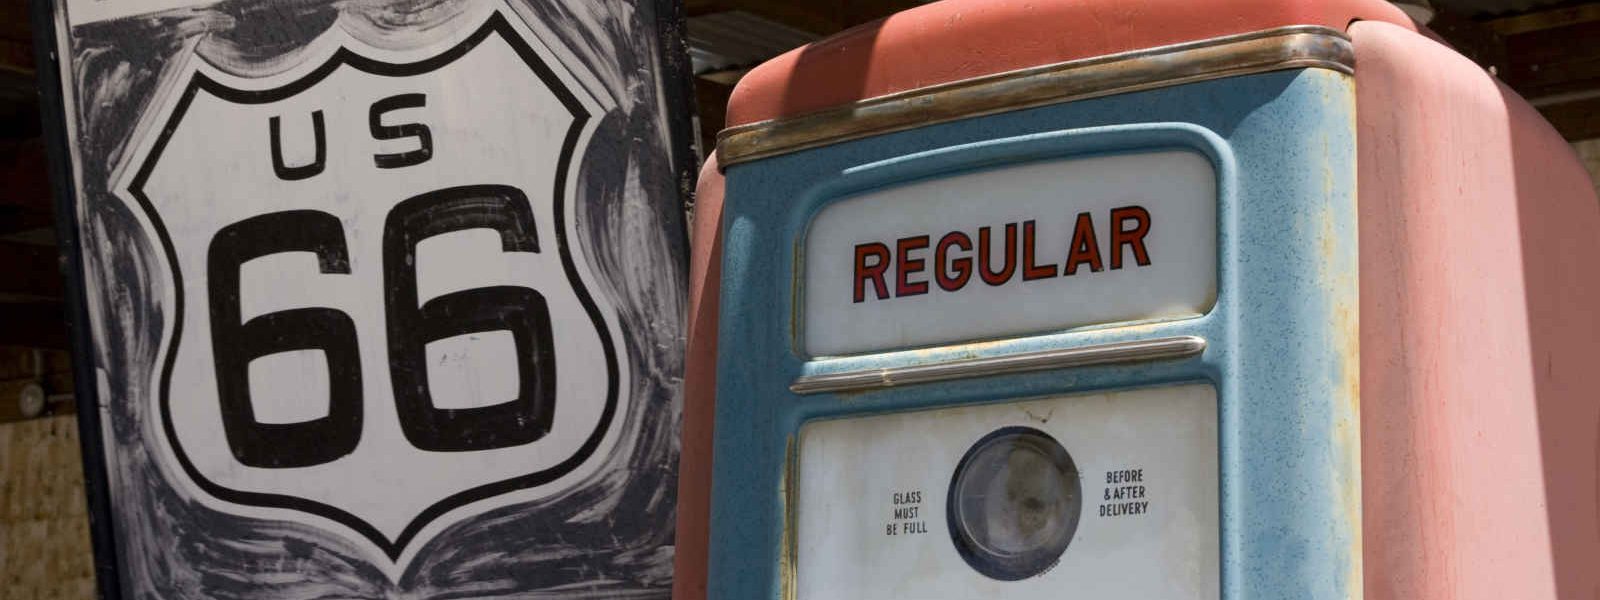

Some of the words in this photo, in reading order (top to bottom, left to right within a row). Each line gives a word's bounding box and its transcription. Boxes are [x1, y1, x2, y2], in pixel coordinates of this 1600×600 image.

[852, 205, 1152, 304] REGULAR
[207, 184, 557, 469] 66
[1106, 469, 1143, 483] BEFORE
[893, 491, 921, 504] GLASS
[1104, 487, 1111, 500] &
[1113, 486, 1145, 499] AFTER
[894, 508, 919, 519] MUST
[1100, 501, 1149, 517] DELIVERY
[886, 524, 898, 536] BE
[903, 521, 928, 534] FULL
